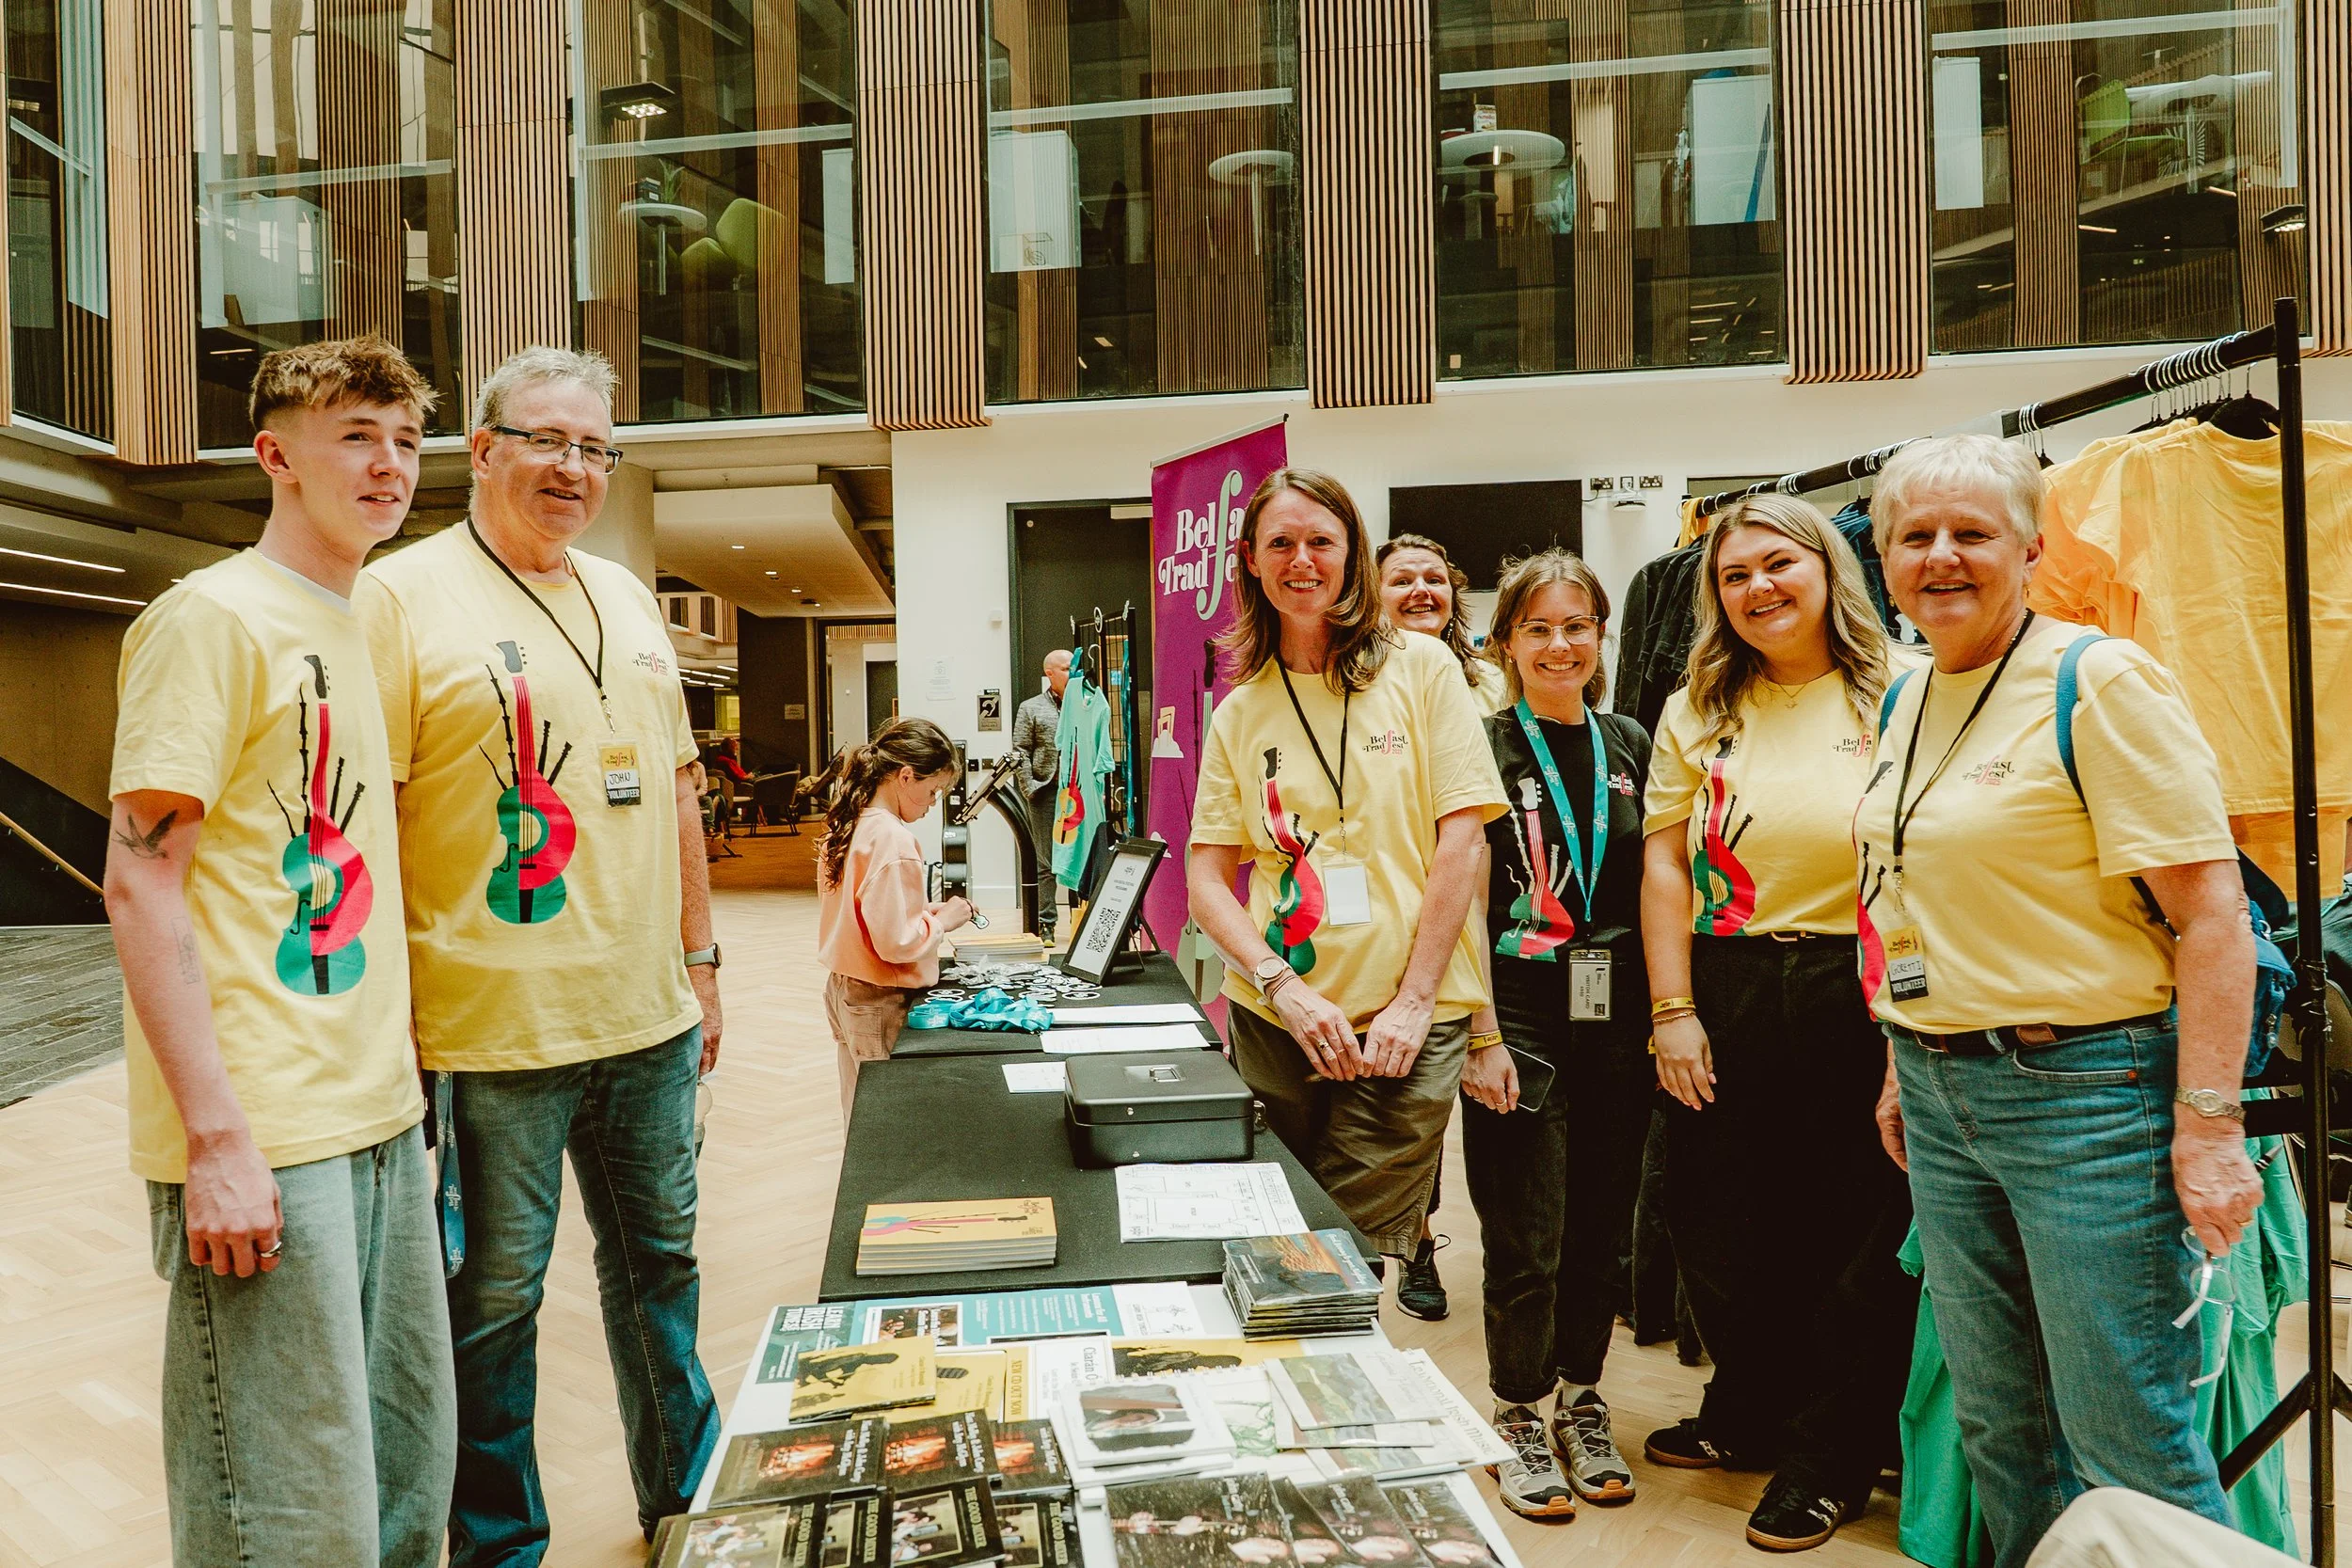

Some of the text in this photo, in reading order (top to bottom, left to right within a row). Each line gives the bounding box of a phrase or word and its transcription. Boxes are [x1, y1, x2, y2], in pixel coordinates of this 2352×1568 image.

[1175, 469, 1244, 557] Belfa
[1370, 730, 1408, 745] Belfast
[1843, 733, 1872, 747] Belfa
[609, 771, 630, 784] JOHN
[800, 1307, 827, 1330] IRISH
[823, 1306, 844, 1328] LEARN
[1010, 1360, 1023, 1415] NEW CD OUT NOW
[1464, 1427, 1496, 1456] Music
[964, 1486, 978, 1502] THE
[802, 1502, 815, 1519] THE
[866, 1498, 880, 1514] THE
[967, 1502, 983, 1523] GOOD
[1049, 1501, 1061, 1517] THE
[799, 1518, 813, 1541] GOOD
[866, 1514, 879, 1536] GOOD
[1051, 1517, 1065, 1539] GOOD
